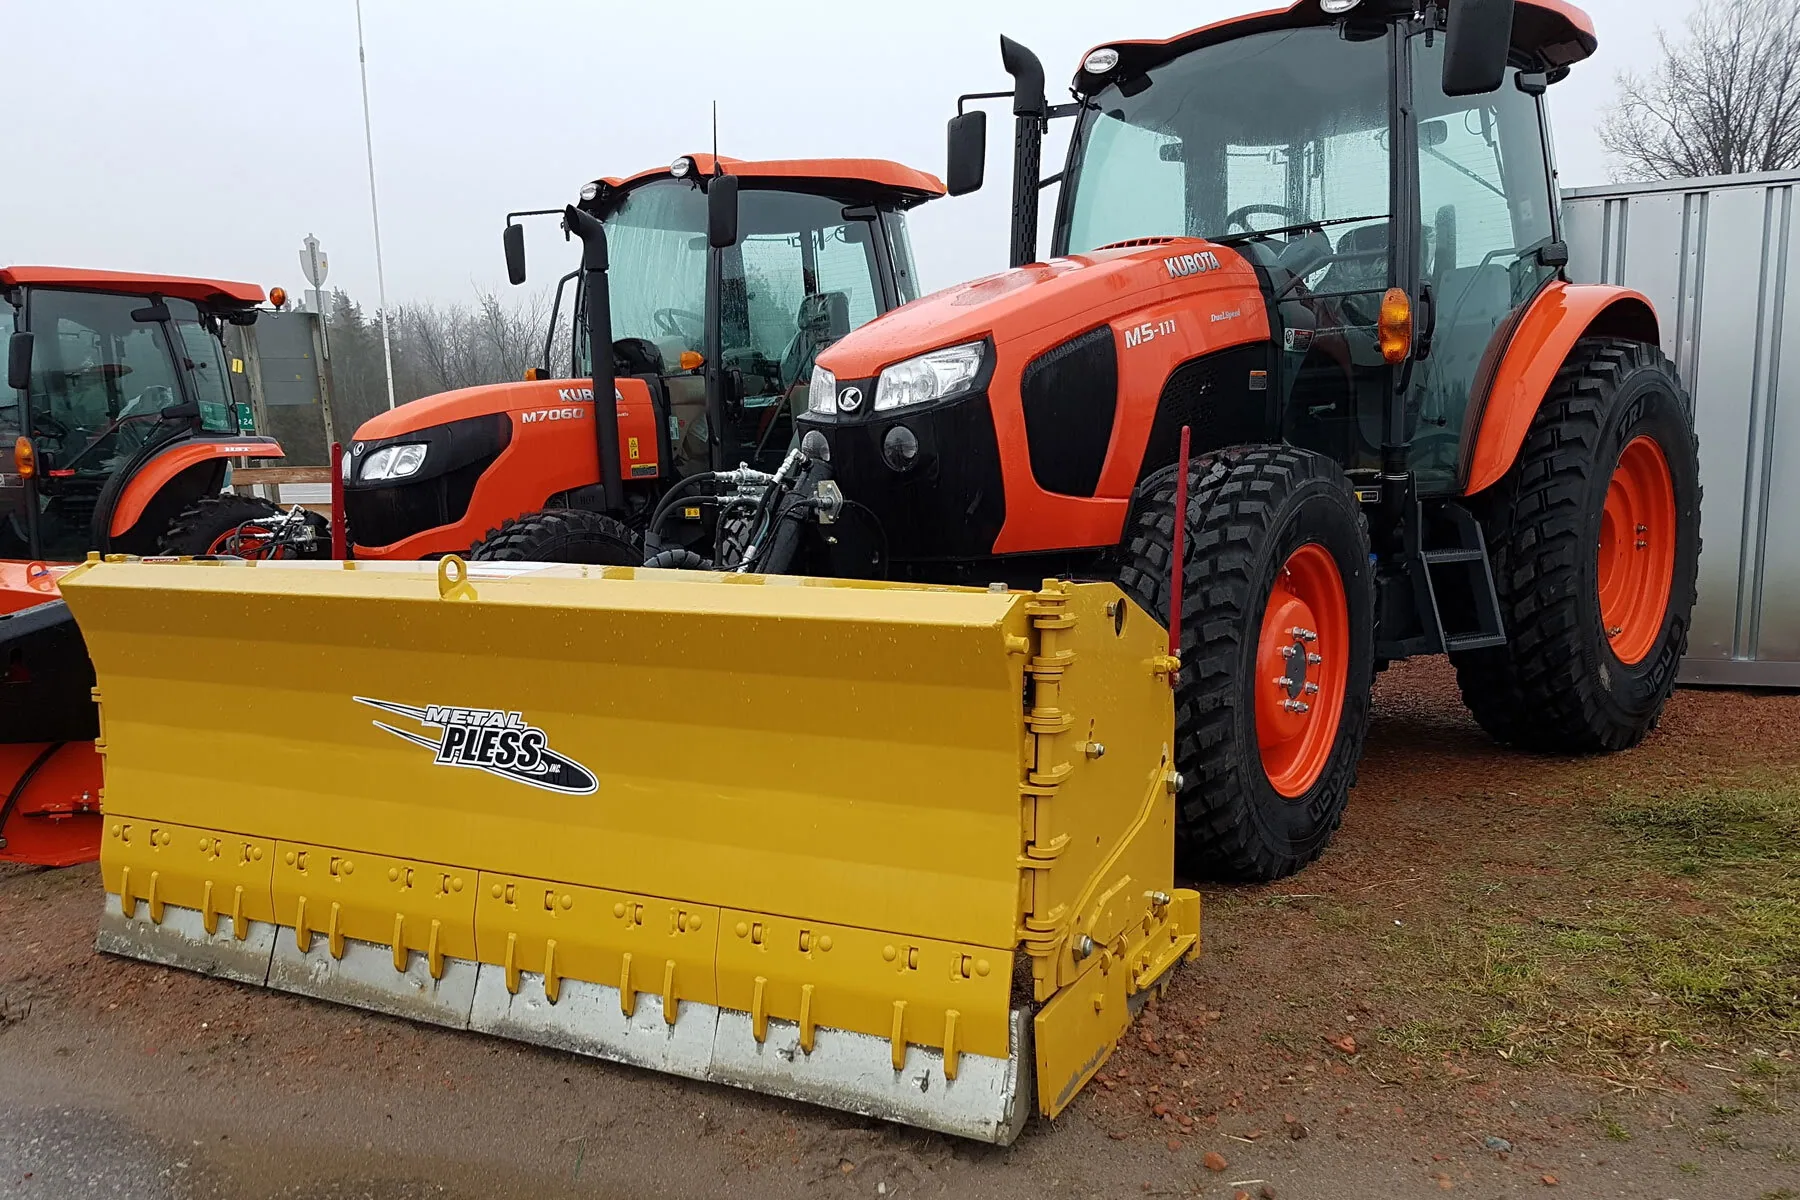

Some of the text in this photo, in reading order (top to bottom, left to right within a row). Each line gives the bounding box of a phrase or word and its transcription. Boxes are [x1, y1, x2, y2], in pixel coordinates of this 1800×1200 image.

[1163, 251, 1221, 278] KUBOTA
[1124, 320, 1176, 349] M5-111
[558, 388, 624, 402] KUBA
[243, 418, 253, 426] 24
[522, 408, 585, 424] M7060
[425, 706, 525, 730] METAL
[441, 726, 542, 771] PLESS
